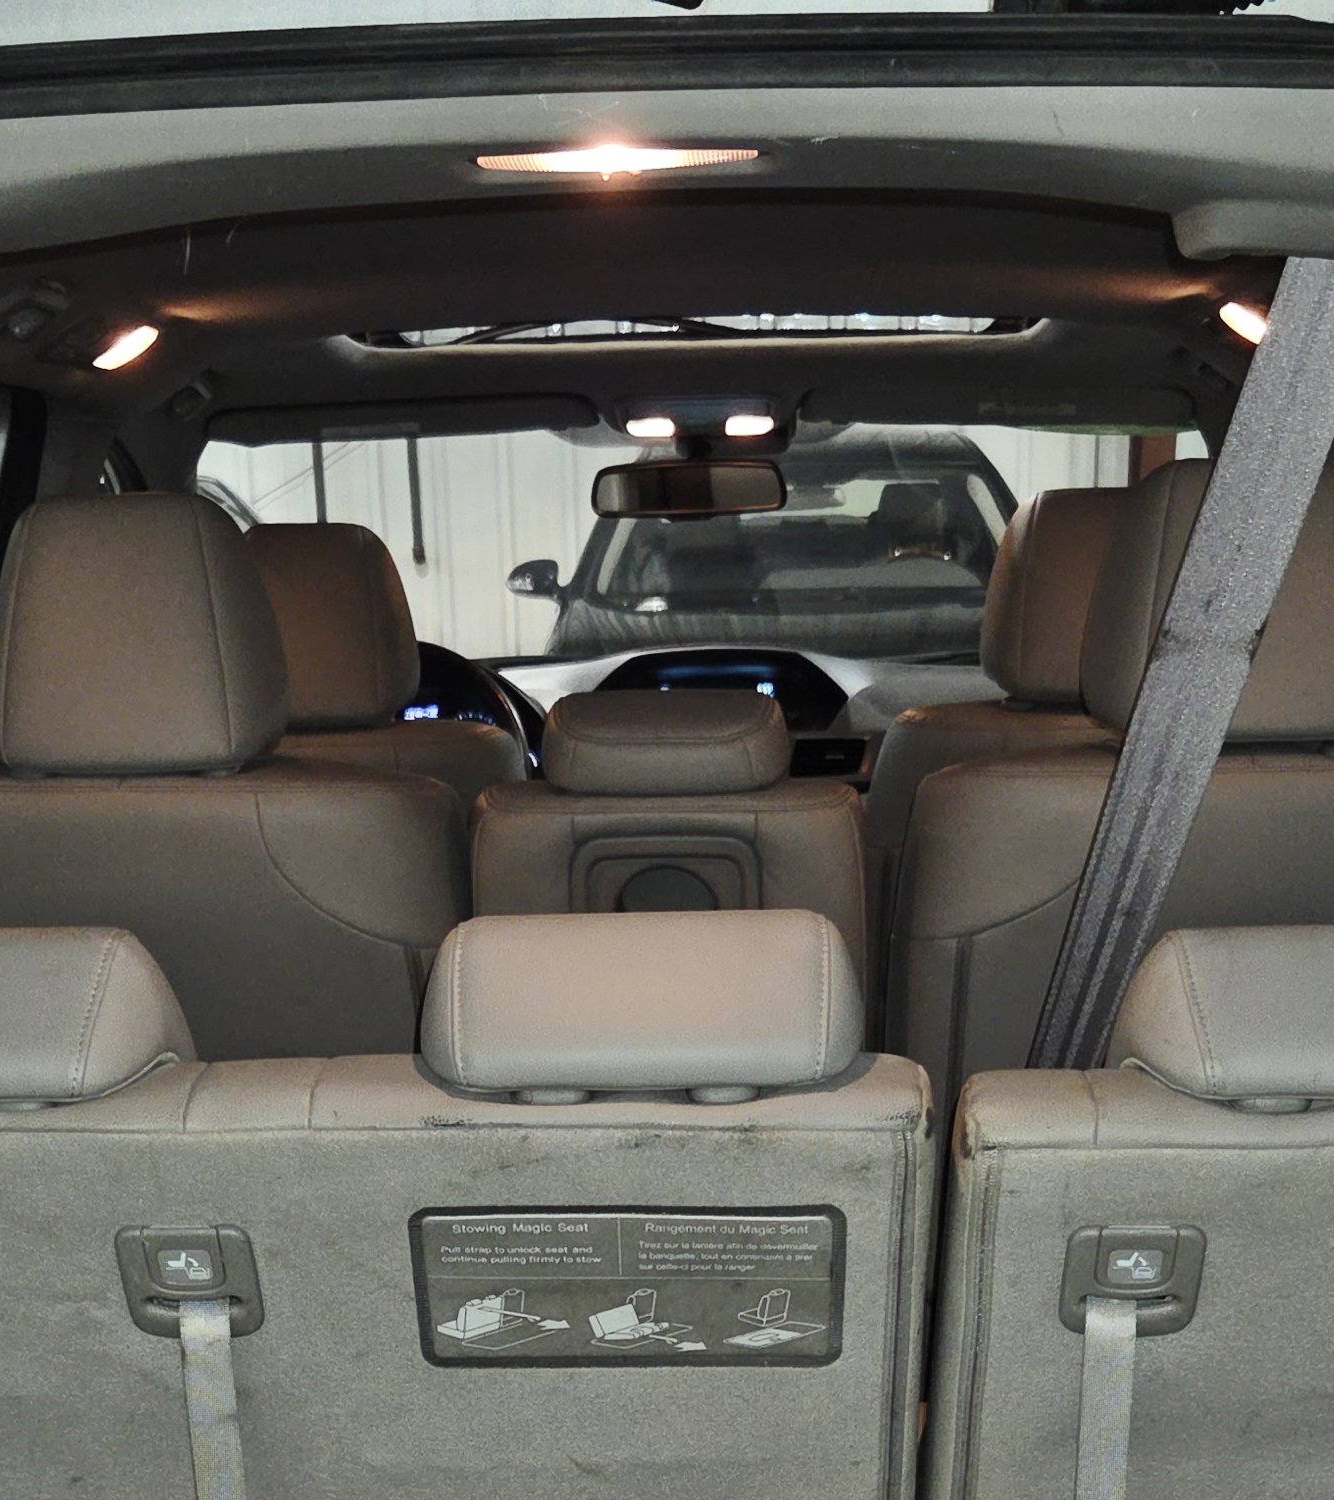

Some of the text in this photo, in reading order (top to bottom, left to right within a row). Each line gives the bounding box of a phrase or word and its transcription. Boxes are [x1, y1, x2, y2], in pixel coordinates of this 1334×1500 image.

[452, 1222, 590, 1235] Stowing Magic Seat
[720, 1223, 735, 1234] du
[739, 1224, 777, 1236] Magic
[779, 1224, 809, 1235] Seat
[440, 1245, 593, 1255] Pull strap to unlock seat and
[441, 1256, 488, 1264] continue
[490, 1255, 527, 1265] pulling
[529, 1255, 561, 1265] firmly
[563, 1256, 574, 1264] to
